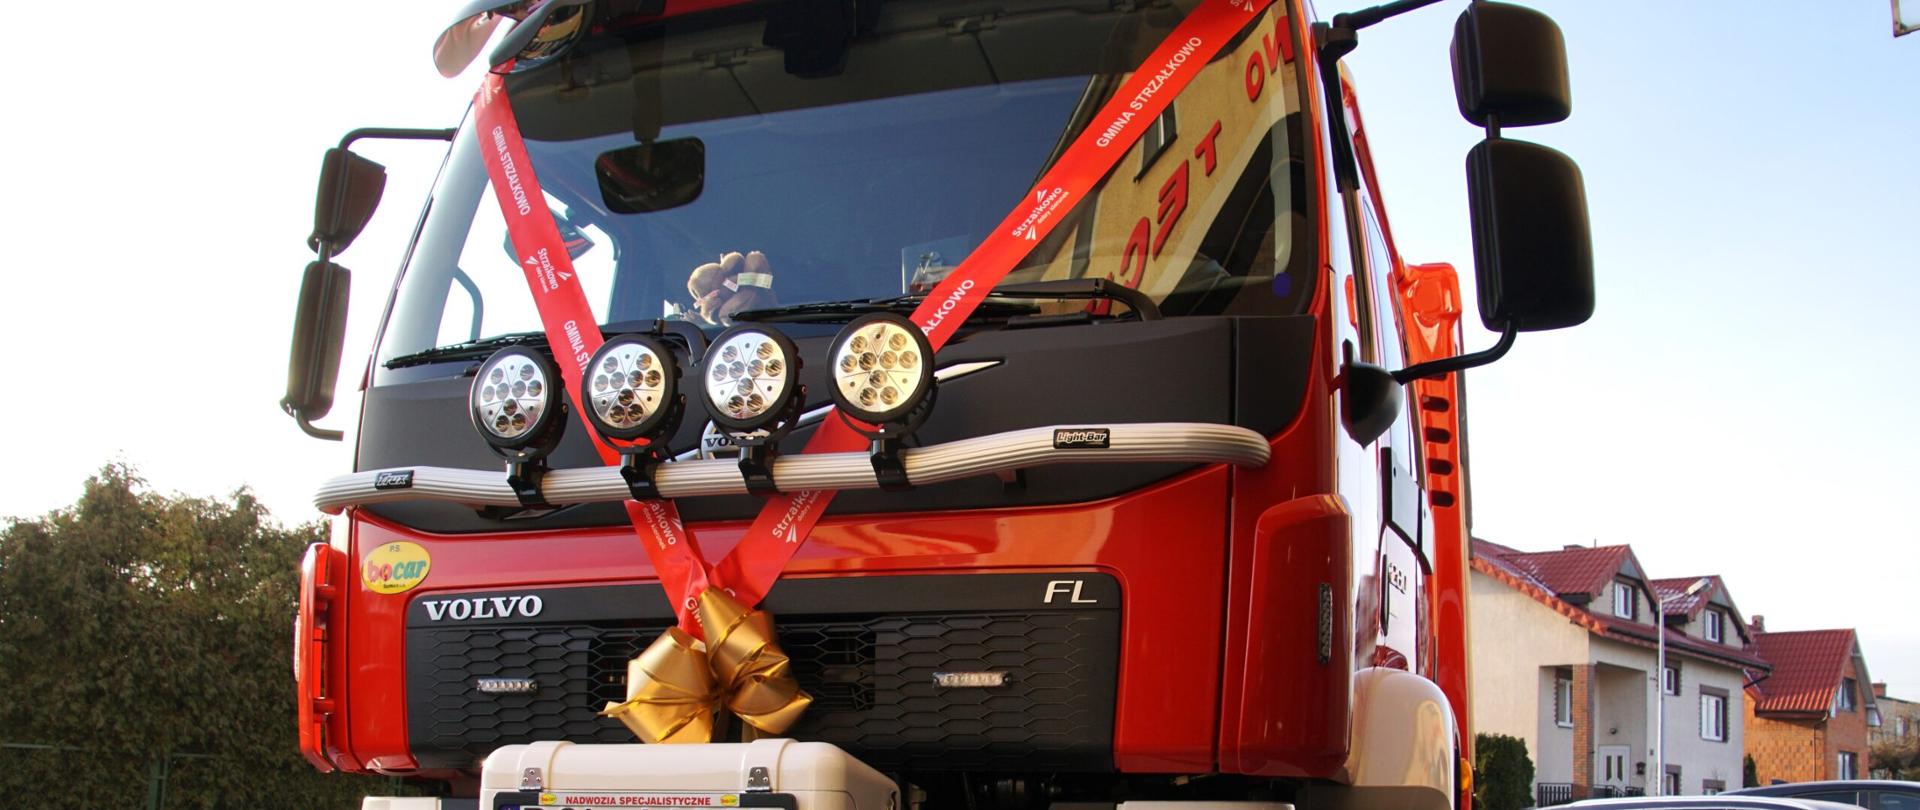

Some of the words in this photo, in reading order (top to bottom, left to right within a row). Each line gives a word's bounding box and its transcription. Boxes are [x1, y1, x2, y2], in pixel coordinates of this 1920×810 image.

[1096, 110, 1136, 148] GMINA
[1129, 36, 1202, 111] STRZAŁKOWO
[492, 125, 508, 156] GMINA
[563, 320, 585, 356] GMINA
[1057, 431, 1107, 444] Light-Bar
[367, 560, 427, 583] bocar
[1043, 580, 1098, 603] FL
[422, 595, 543, 621] VOLVO
[565, 796, 617, 805] NADWOZIA
[619, 796, 711, 805] SPECJALISTYCZNE
